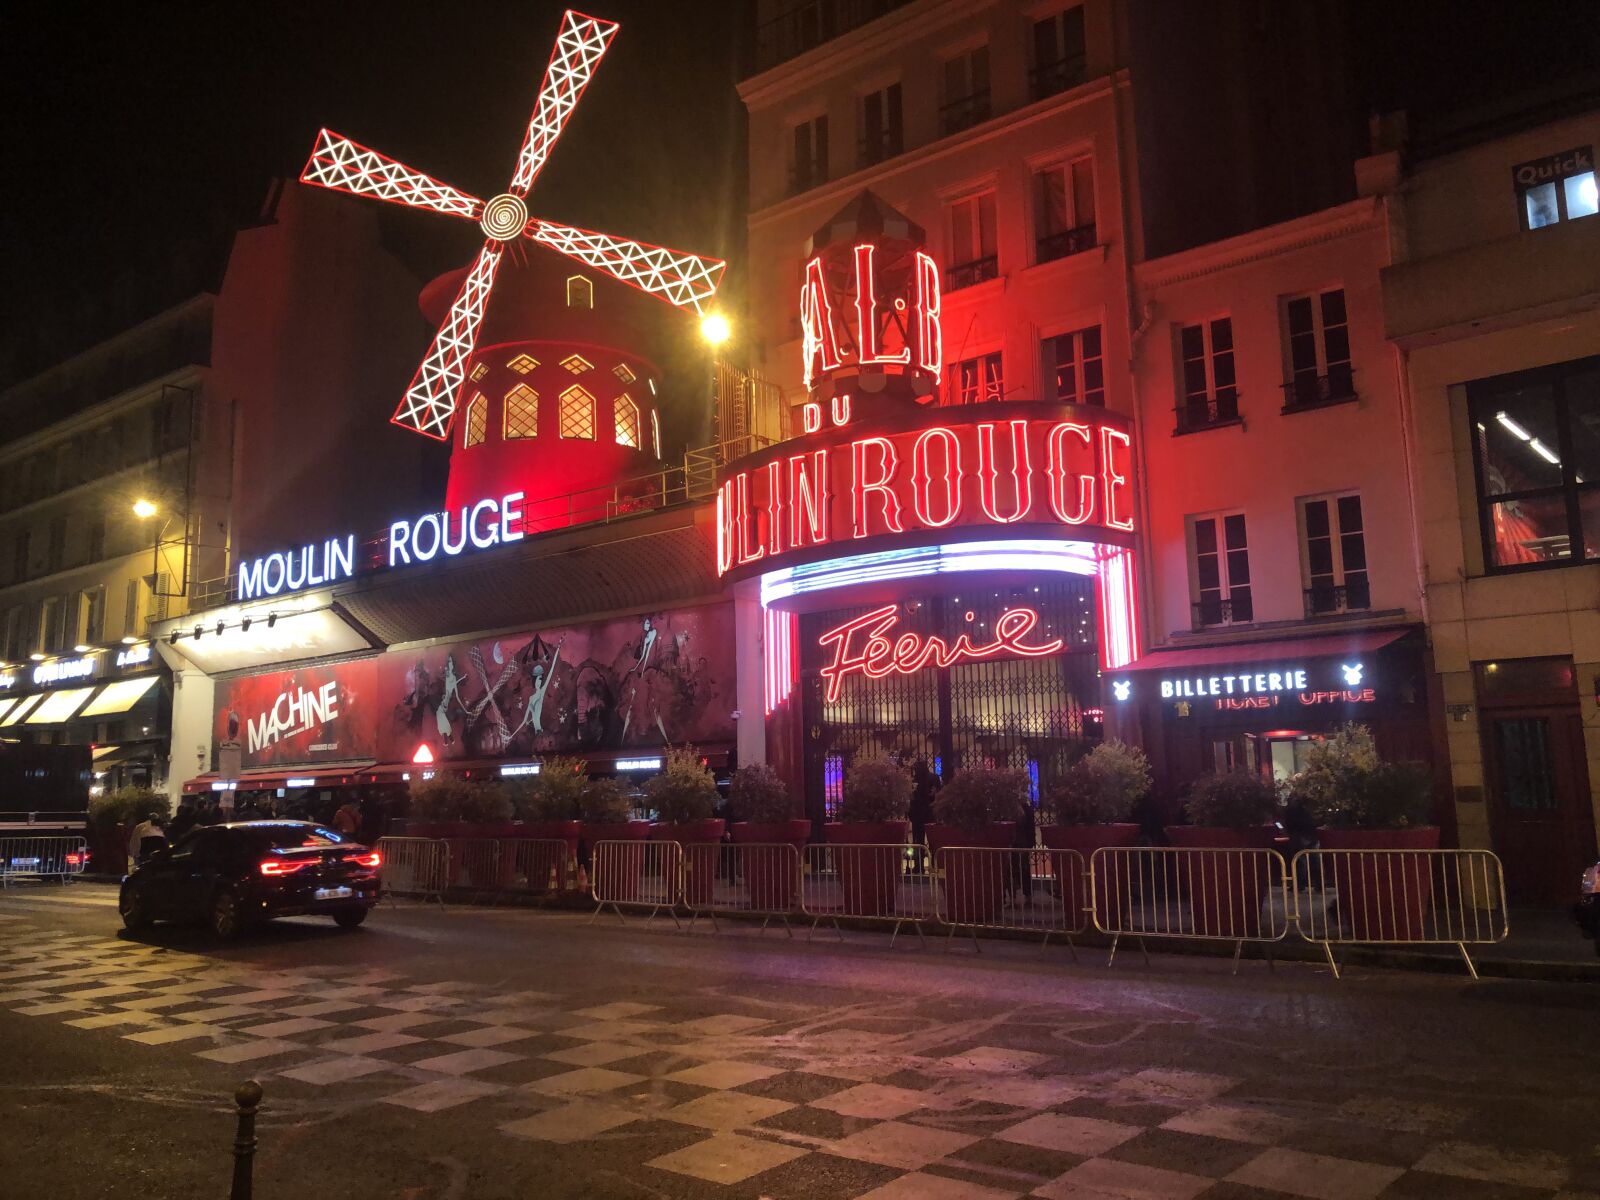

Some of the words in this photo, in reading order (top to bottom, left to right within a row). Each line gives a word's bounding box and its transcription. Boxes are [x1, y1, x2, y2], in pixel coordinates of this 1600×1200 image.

[1516, 151, 1589, 185] Quick
[803, 394, 850, 433] DU
[851, 420, 1134, 539] ROUGE
[238, 534, 354, 600] MOULIN
[389, 491, 524, 567] ROUGE
[819, 604, 1063, 703] Féerie
[1160, 670, 1308, 699] BILLETTERIE
[247, 680, 339, 754] MACHINE
